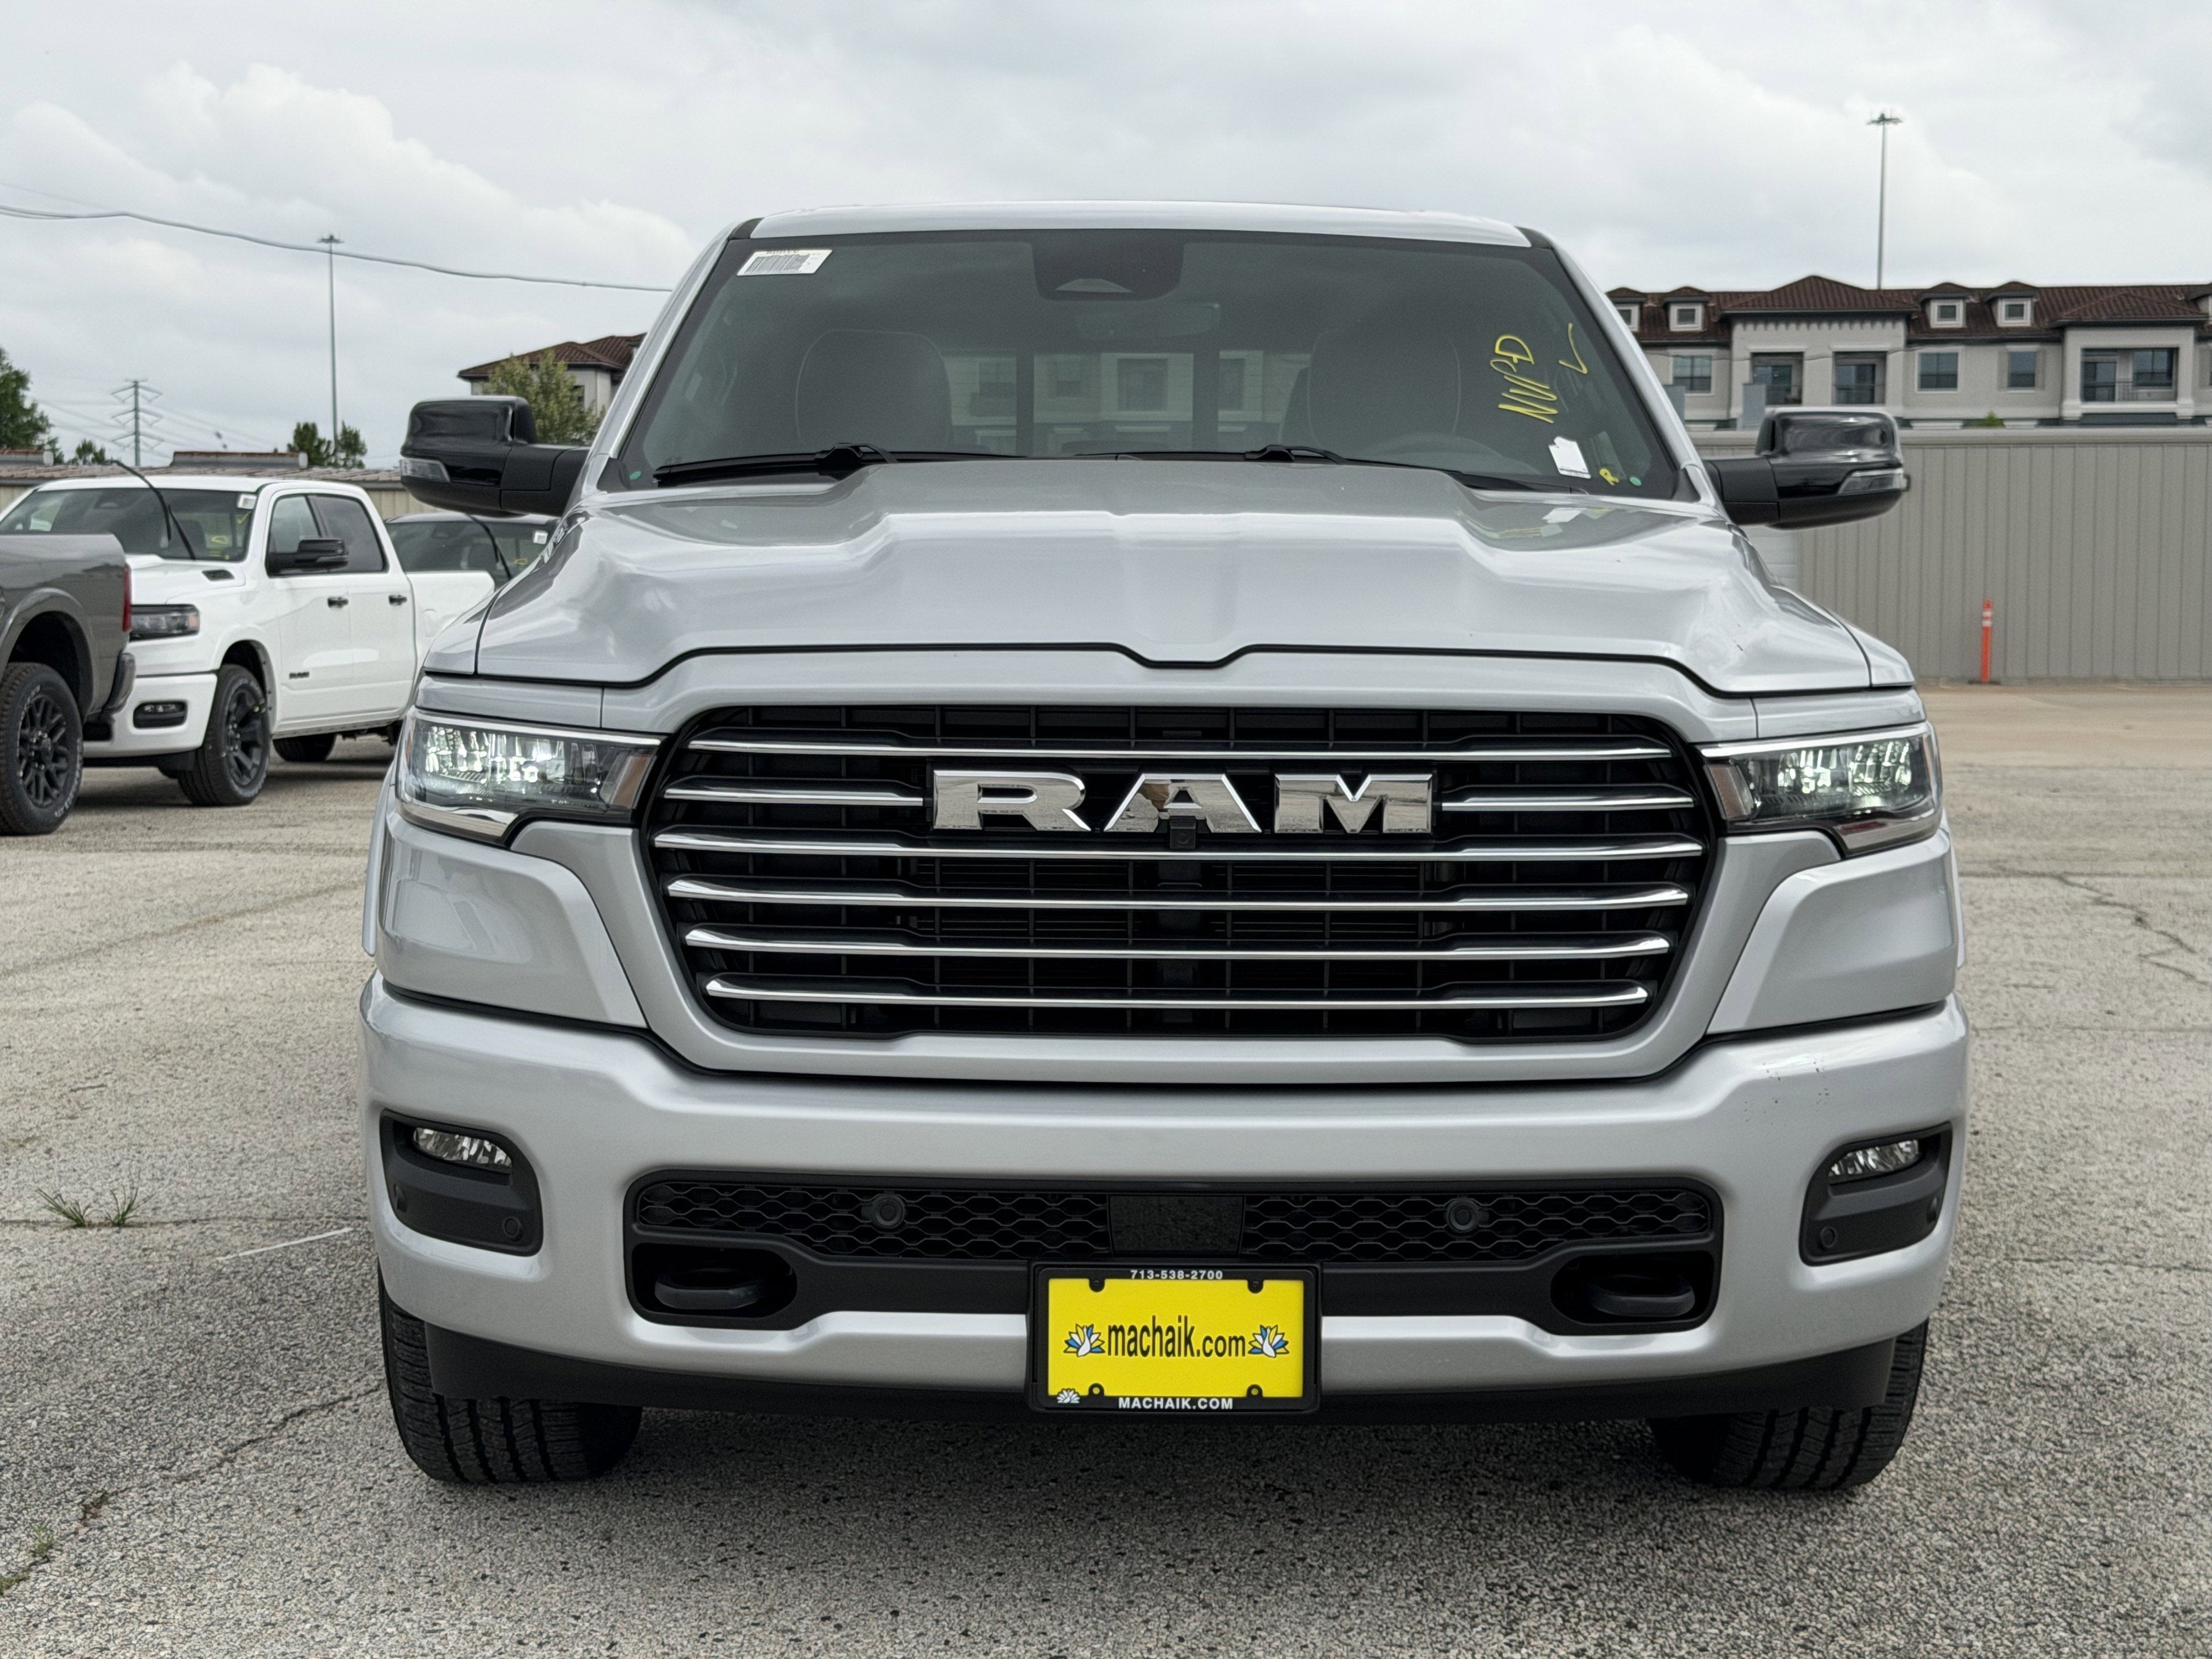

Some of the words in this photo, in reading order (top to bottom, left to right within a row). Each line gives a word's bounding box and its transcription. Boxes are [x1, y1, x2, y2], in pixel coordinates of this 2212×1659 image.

[933, 770, 1433, 834] RAM
[1130, 1269, 1223, 1279] 713-538-2700
[1107, 1314, 1246, 1358] machaik.com
[1118, 1397, 1234, 1410] MACHAIK.COM
